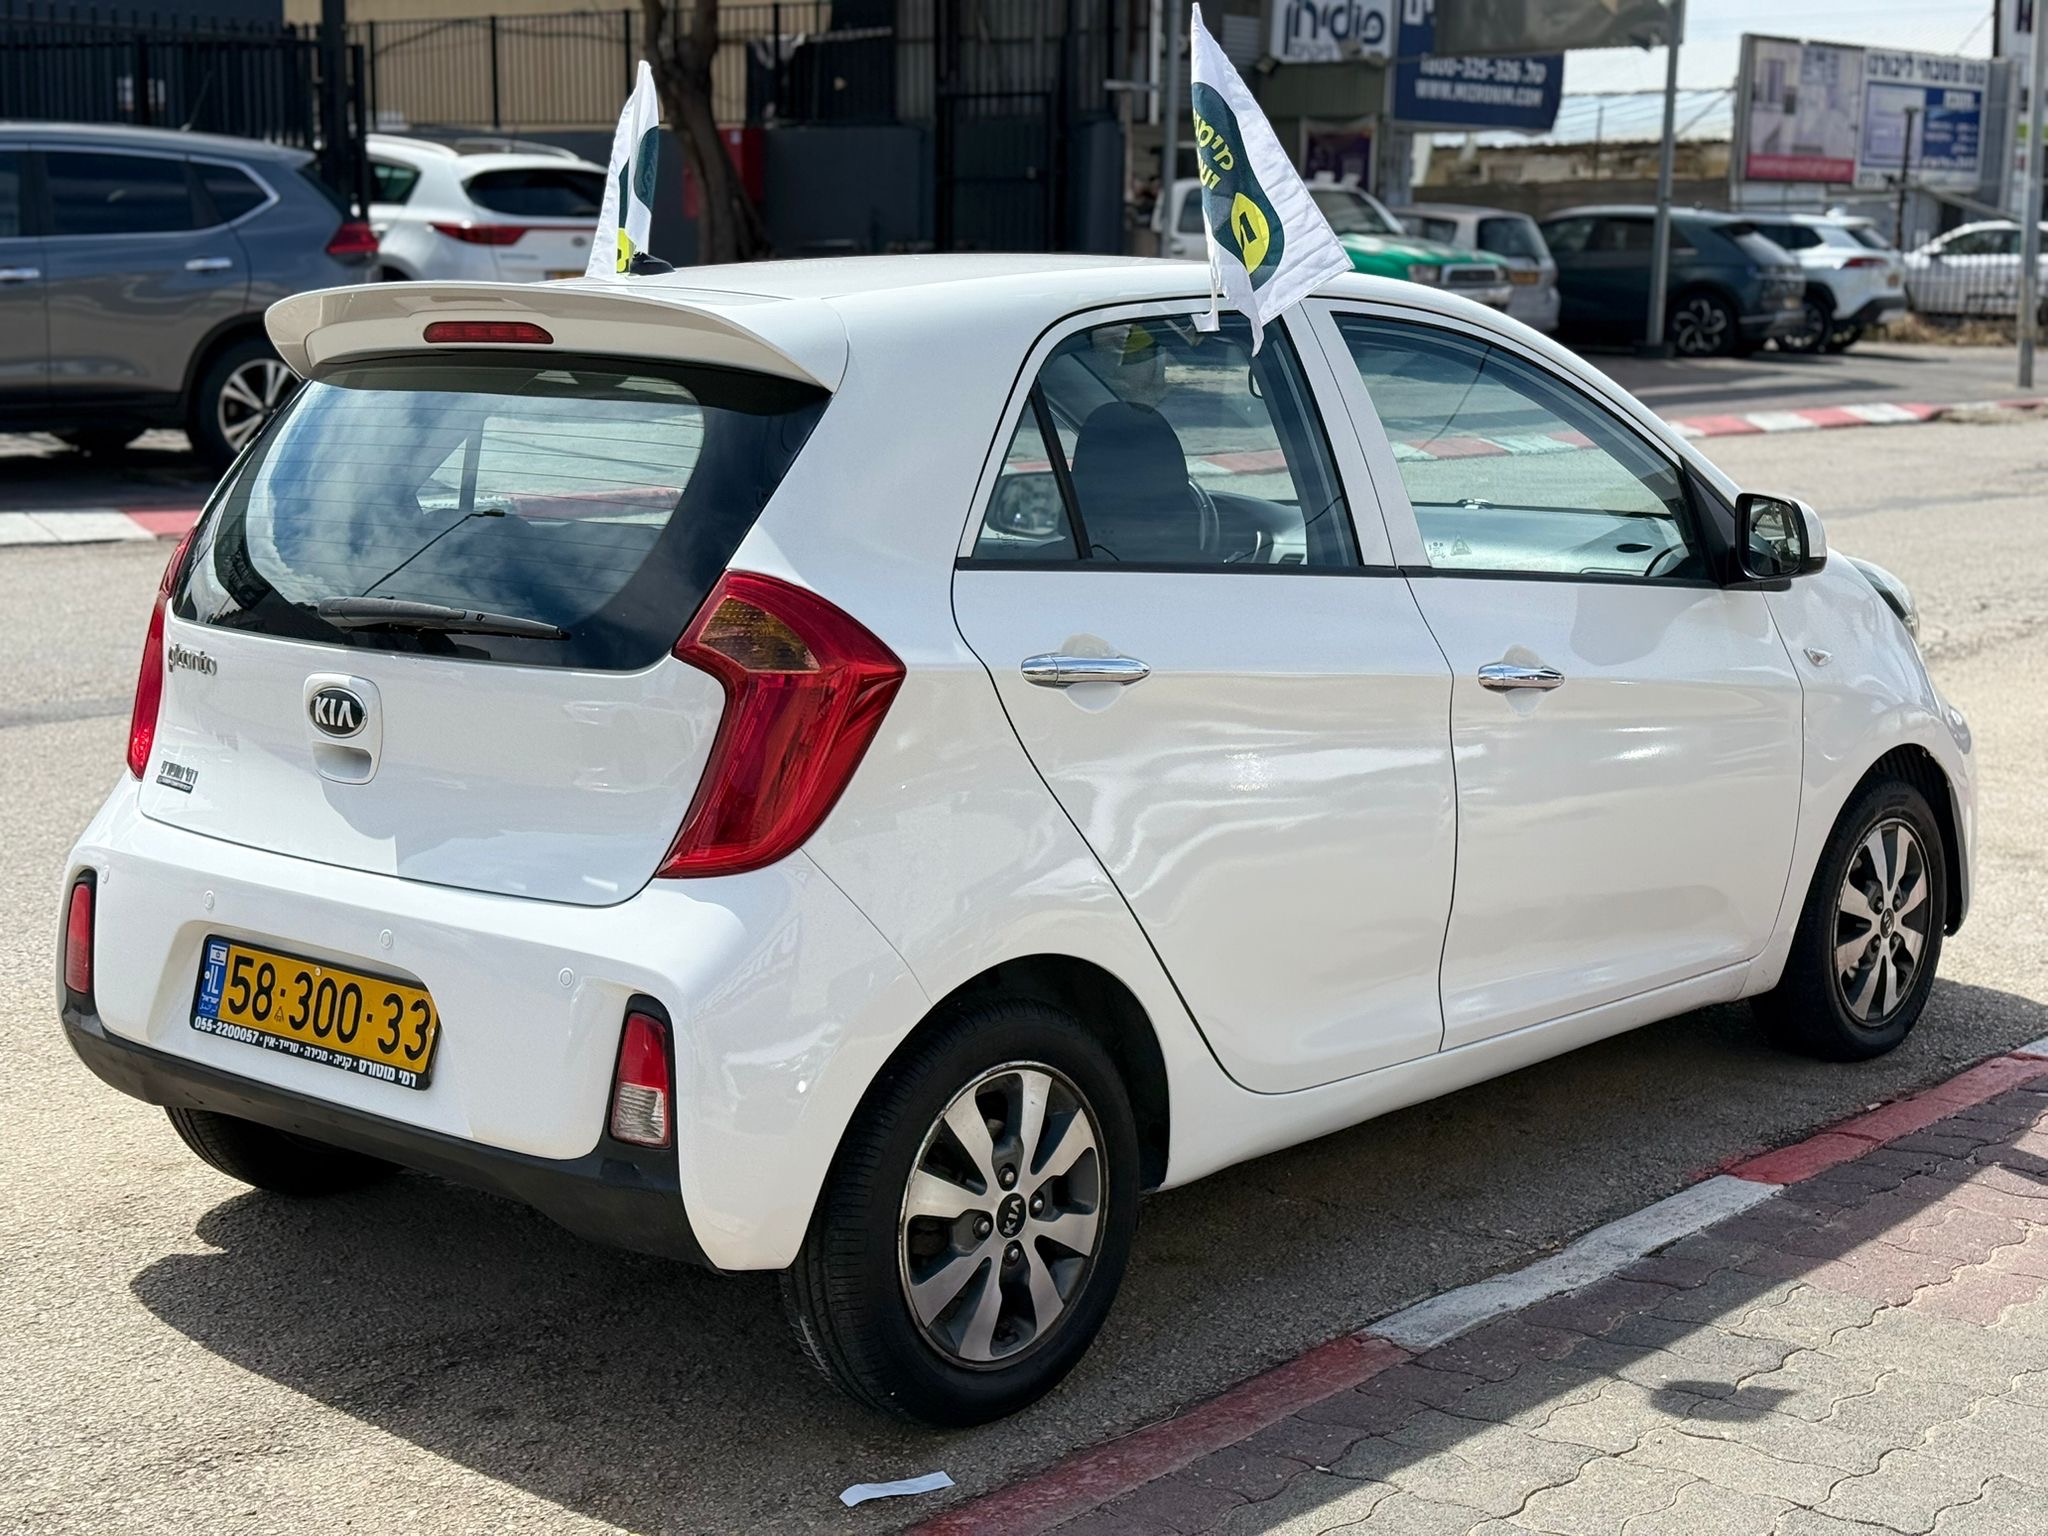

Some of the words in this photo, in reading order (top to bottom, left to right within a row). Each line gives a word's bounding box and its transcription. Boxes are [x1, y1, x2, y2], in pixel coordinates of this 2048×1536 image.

[313, 695, 355, 729] KIA
[207, 965, 219, 994] IL
[194, 1016, 260, 1044] 055-2200057
[304, 1046, 328, 1061] מכירה
[333, 1054, 353, 1070] קניה
[358, 1059, 396, 1081] מוטורס
[398, 1070, 417, 1087] רמי
[1003, 1199, 1022, 1234] KIA
